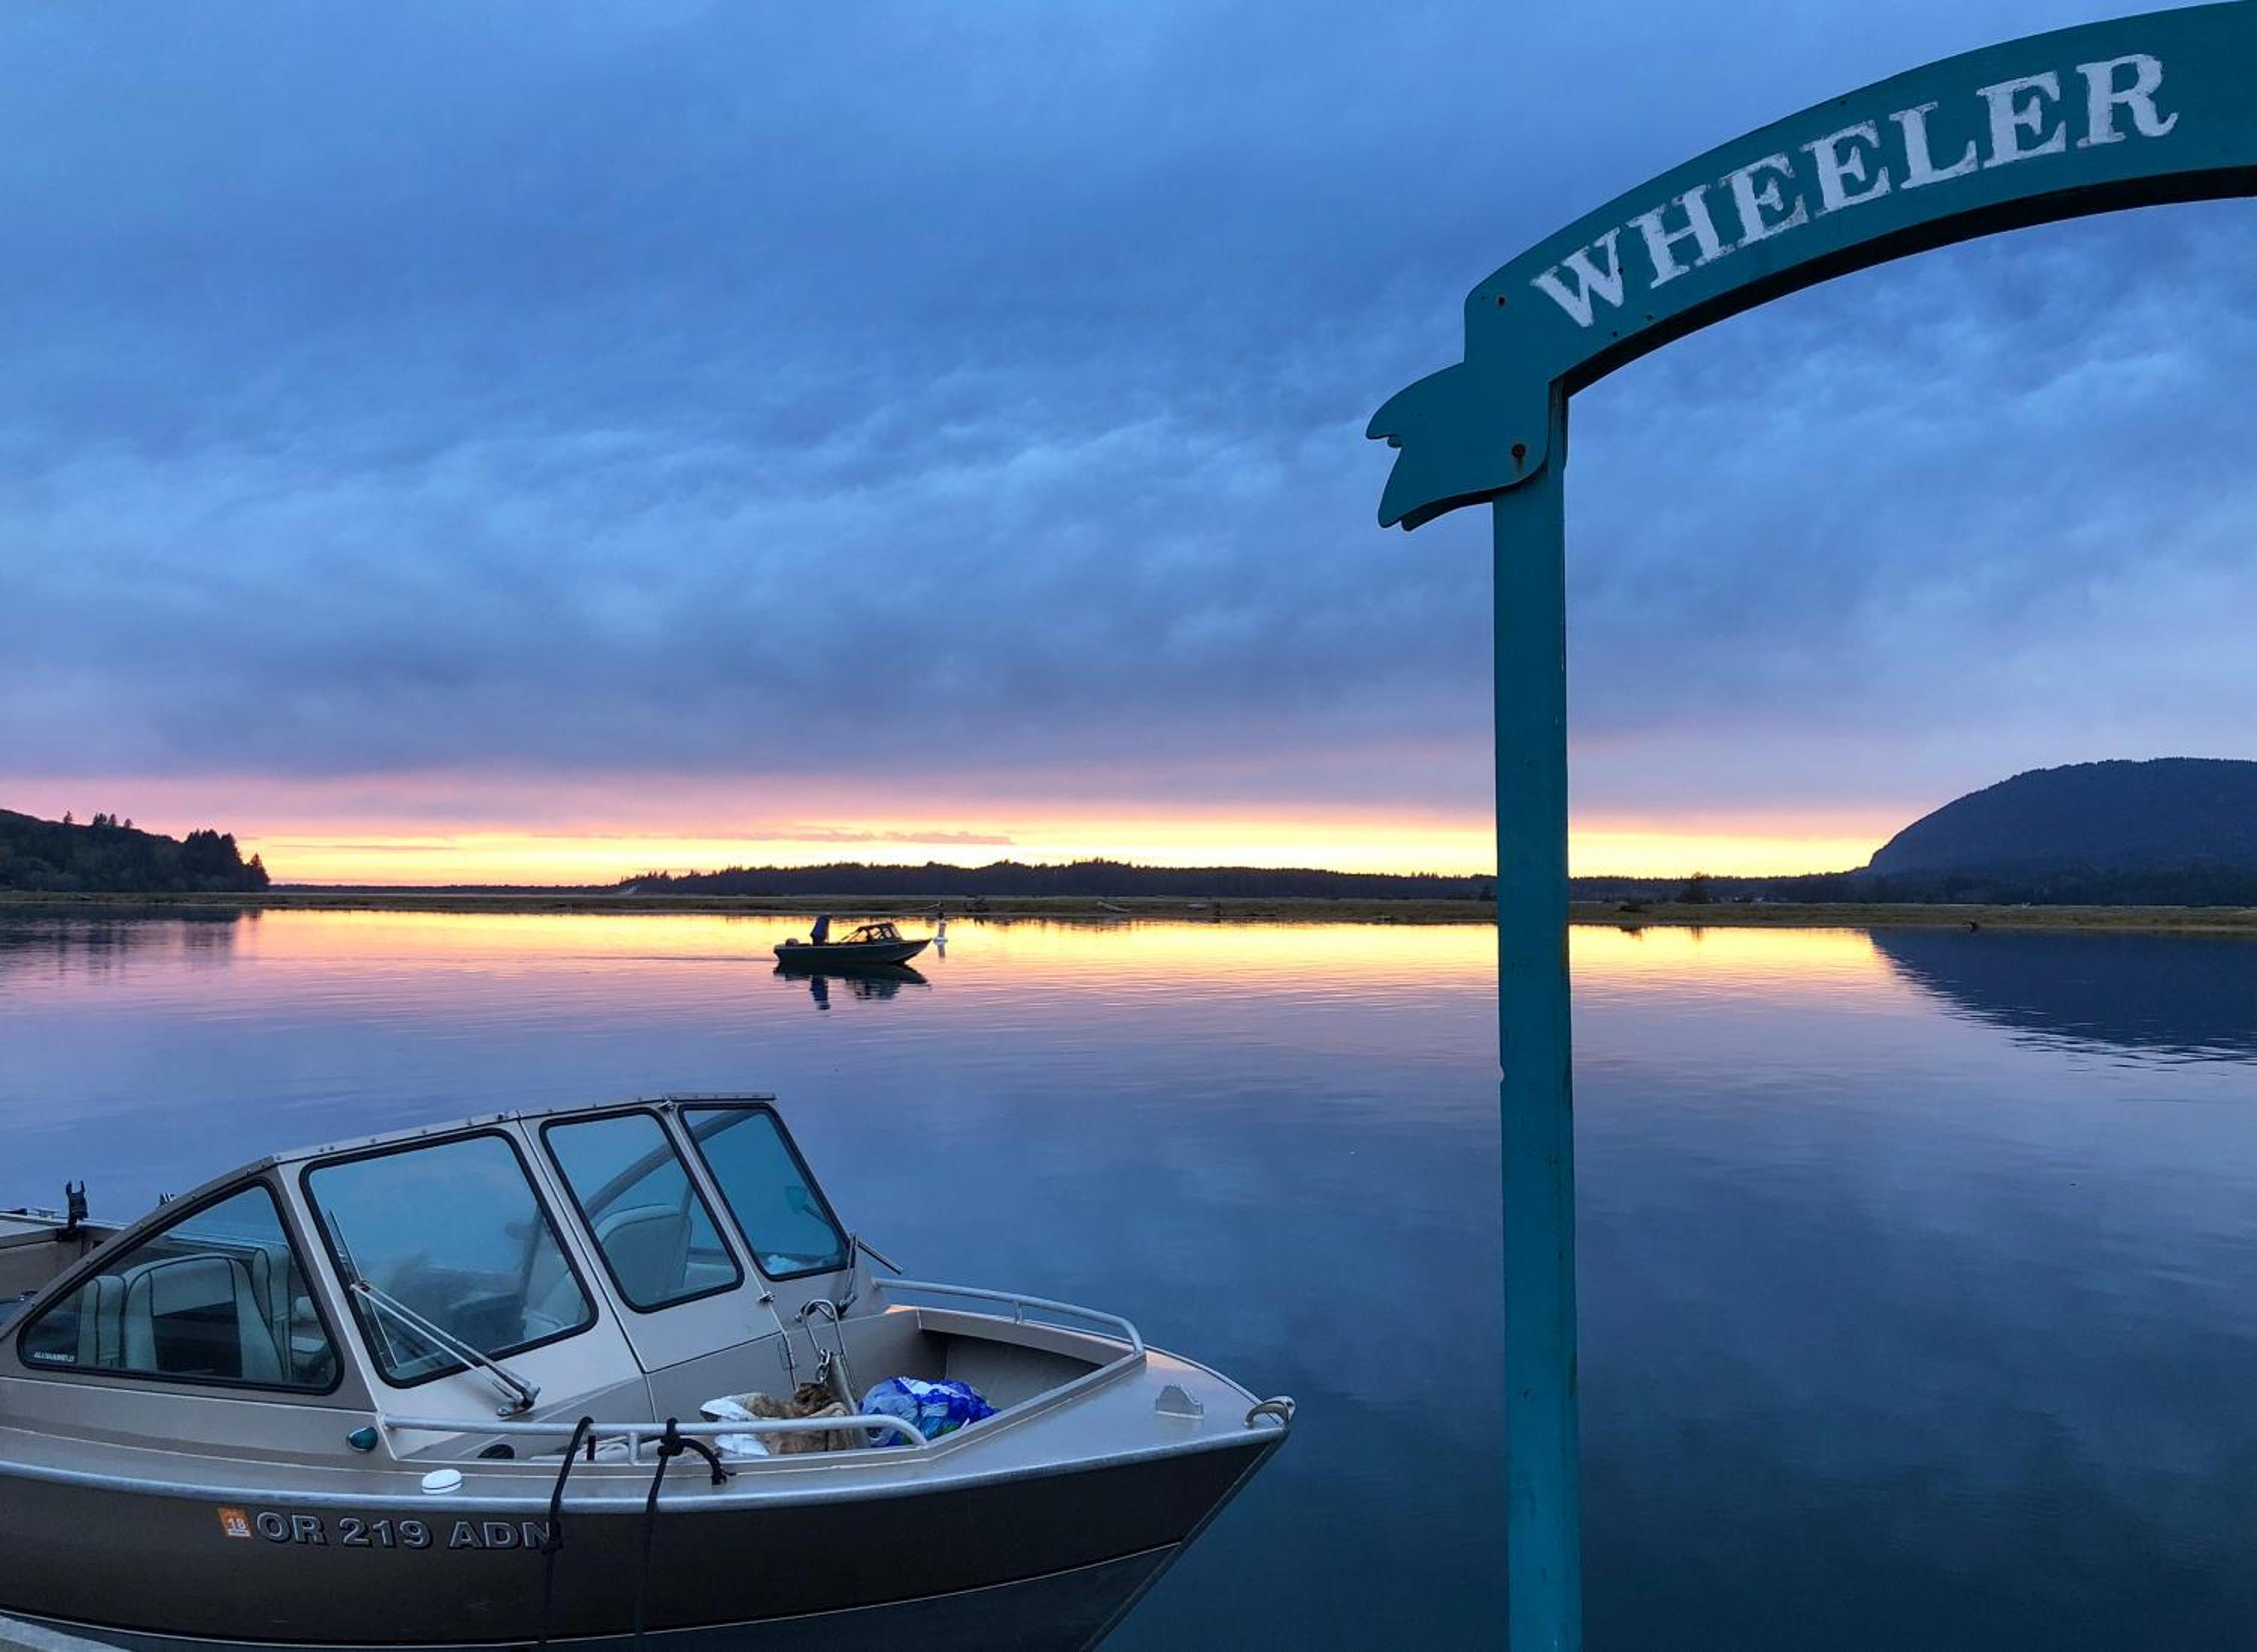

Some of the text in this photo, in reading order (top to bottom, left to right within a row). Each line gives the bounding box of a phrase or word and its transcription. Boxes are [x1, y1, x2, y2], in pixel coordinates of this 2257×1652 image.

[1530, 53, 2179, 328] WHEELER
[257, 1511, 552, 1549] OR 219 ADN
